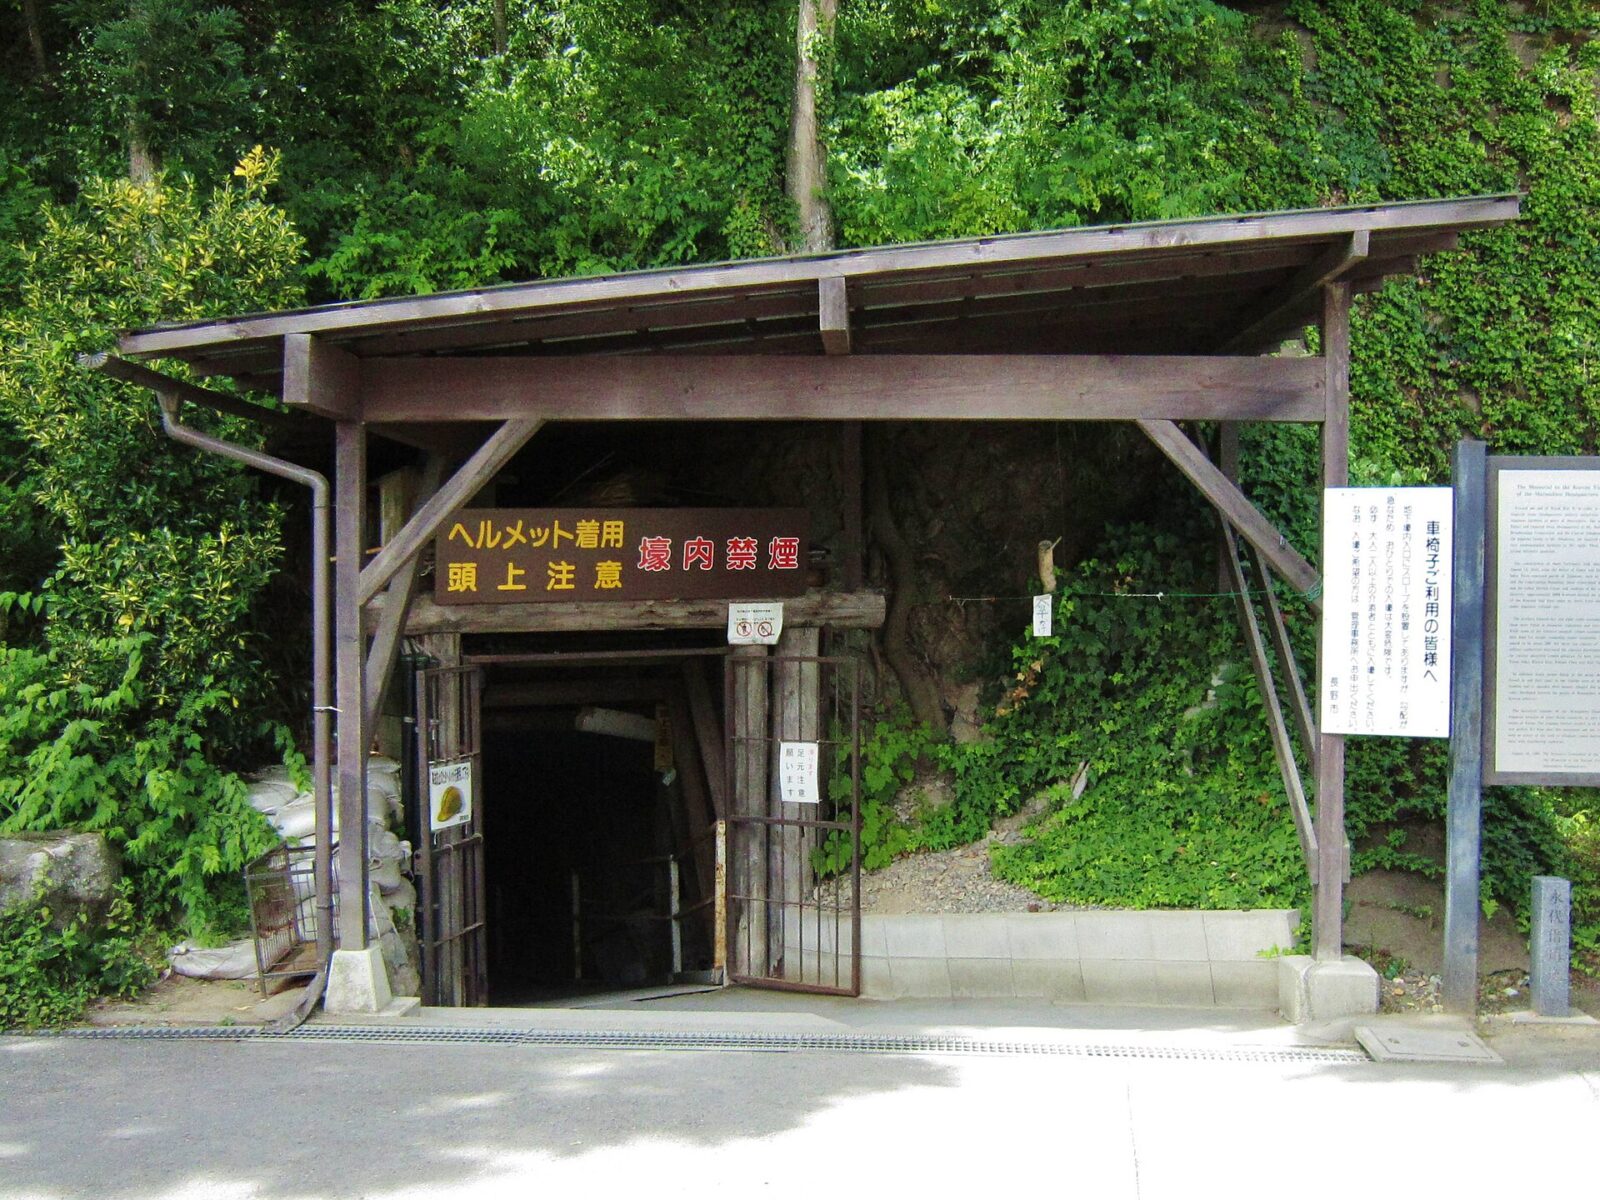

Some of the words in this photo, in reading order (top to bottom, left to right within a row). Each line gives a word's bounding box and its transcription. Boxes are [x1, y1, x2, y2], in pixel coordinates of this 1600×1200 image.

[449, 520, 624, 549] ヘルメット着用
[638, 536, 800, 571] 壕内禁煙
[447, 561, 622, 592] 頭上注意
[1424, 521, 1440, 682] 車椅子ご利用の皆様へ
